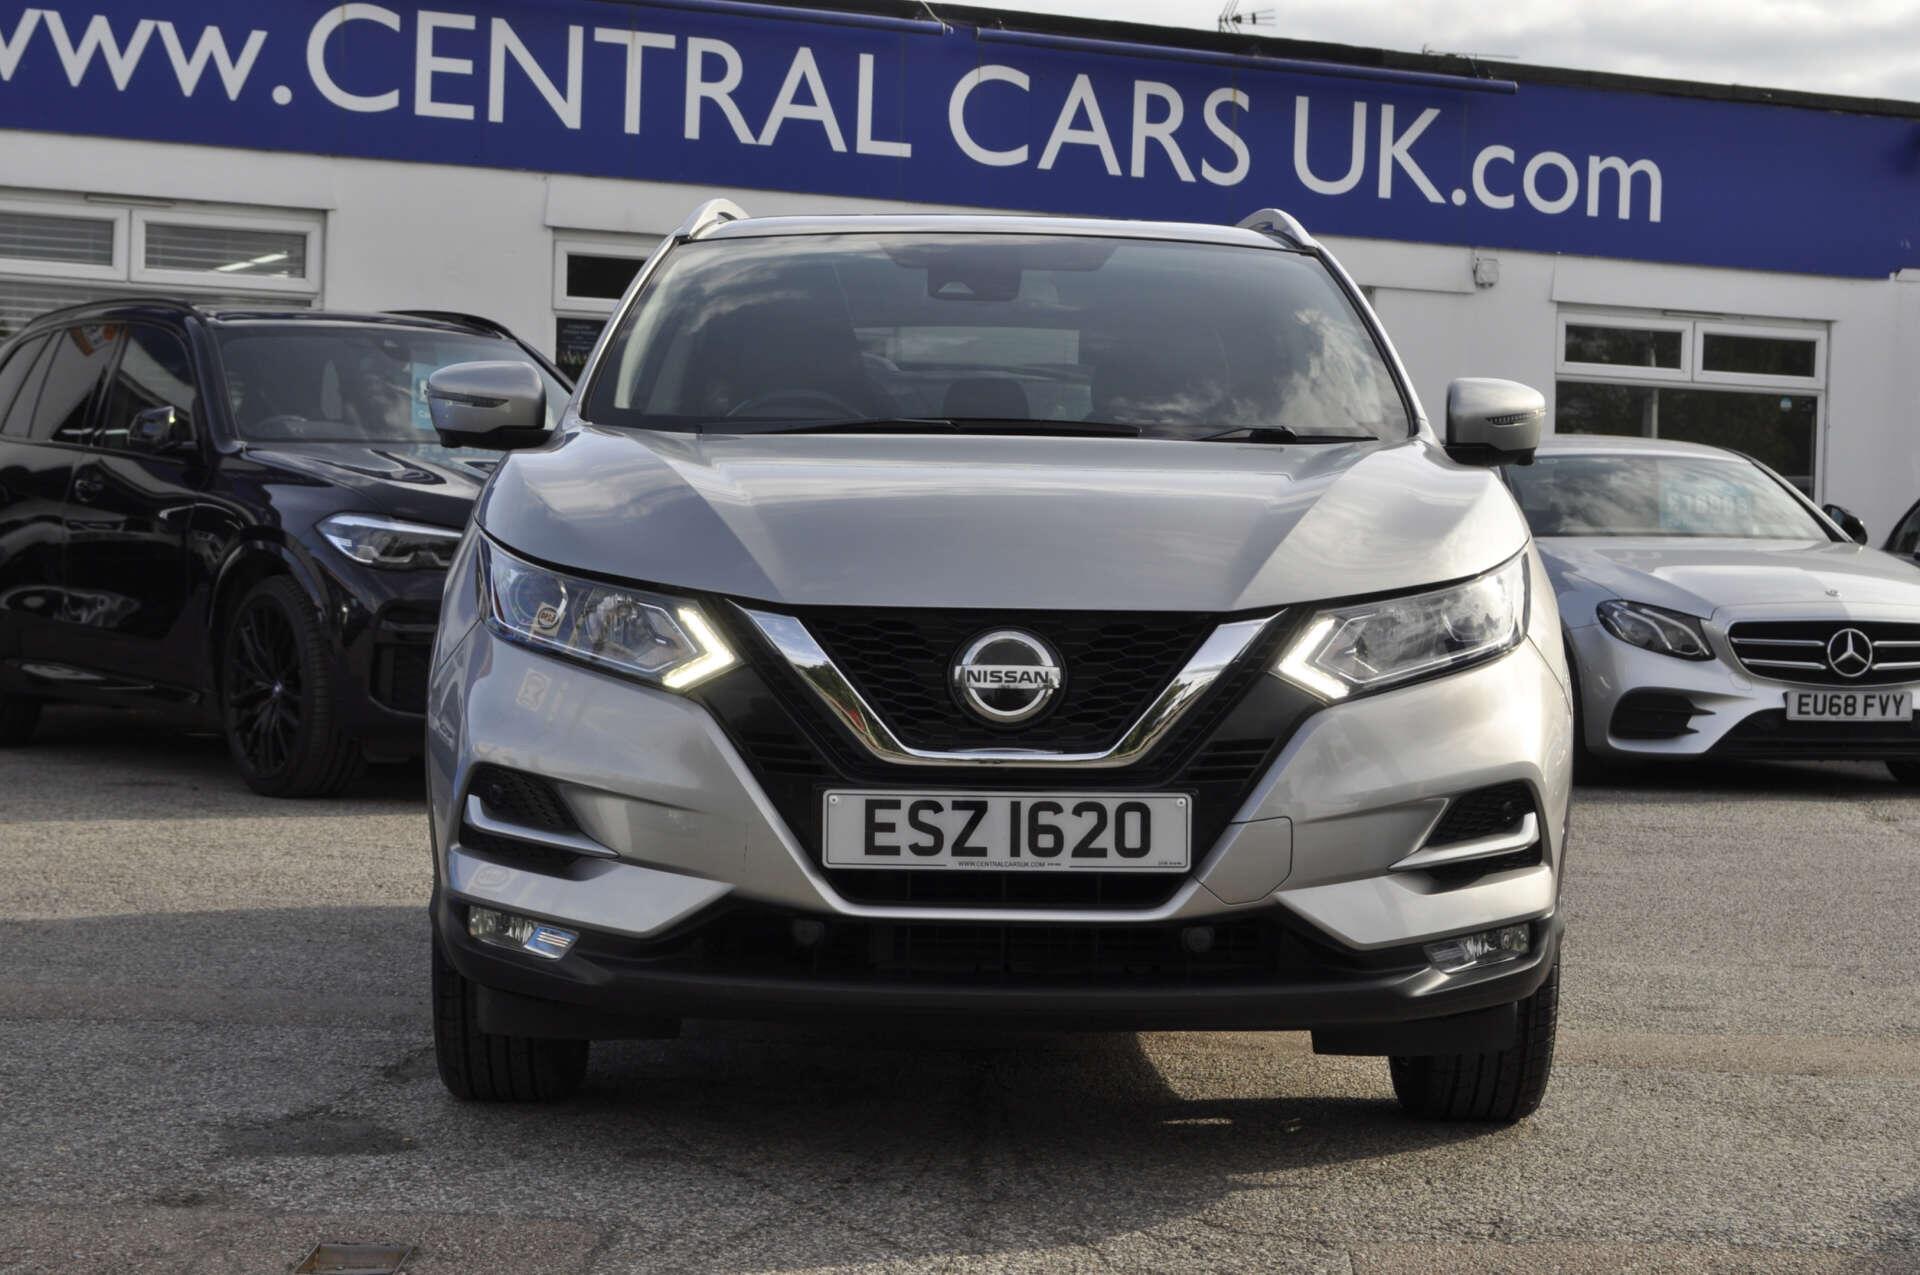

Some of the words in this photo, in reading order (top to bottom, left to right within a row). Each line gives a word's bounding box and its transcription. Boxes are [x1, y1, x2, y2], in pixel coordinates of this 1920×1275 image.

[949, 65, 1250, 186] CARS
[1293, 96, 1662, 222] UK.com
[966, 669, 1049, 684] NISSAN
[1797, 694, 1857, 716] EU68
[1863, 694, 1905, 717] FVY
[864, 798, 988, 858] ESZ
[1010, 800, 1152, 859] 1620
